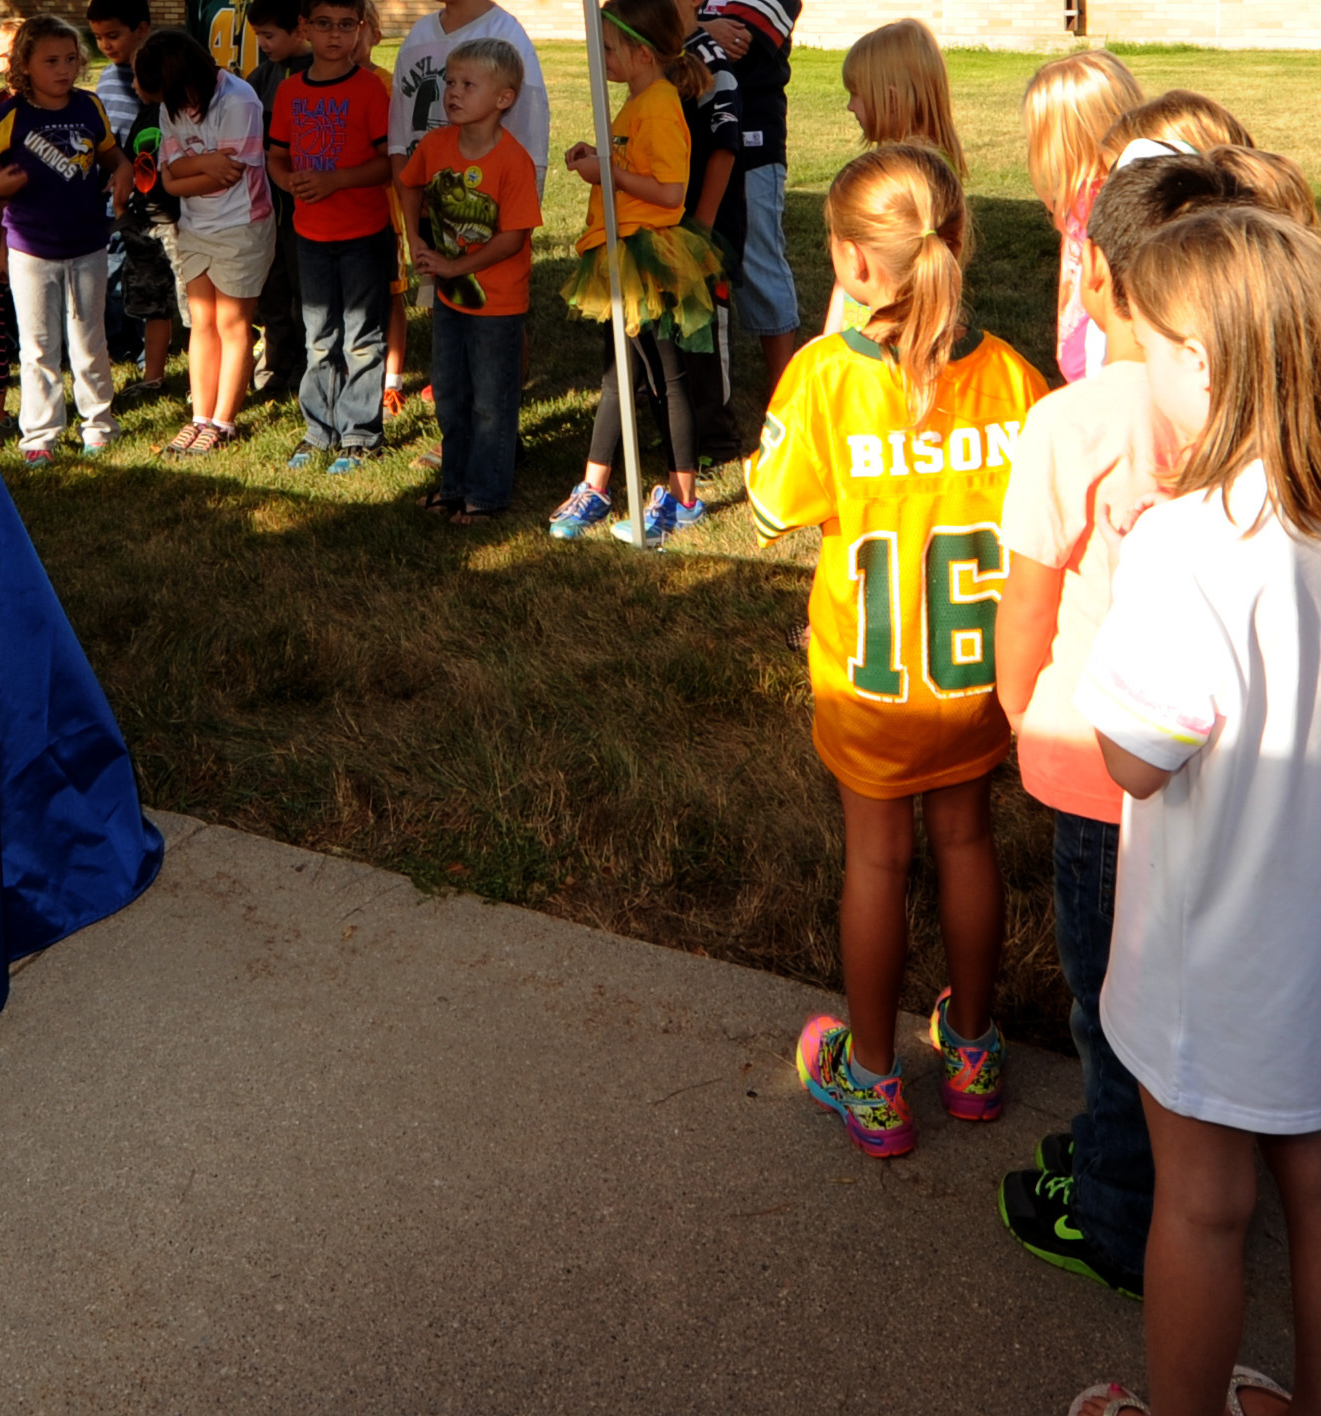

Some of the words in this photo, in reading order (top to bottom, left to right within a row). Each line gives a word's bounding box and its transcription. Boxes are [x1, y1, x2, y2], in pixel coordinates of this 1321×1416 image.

[291, 96, 350, 117] SLAM
[23, 130, 78, 182] VIKINGS
[846, 420, 1021, 478] BISON
[847, 521, 1010, 704] 16
